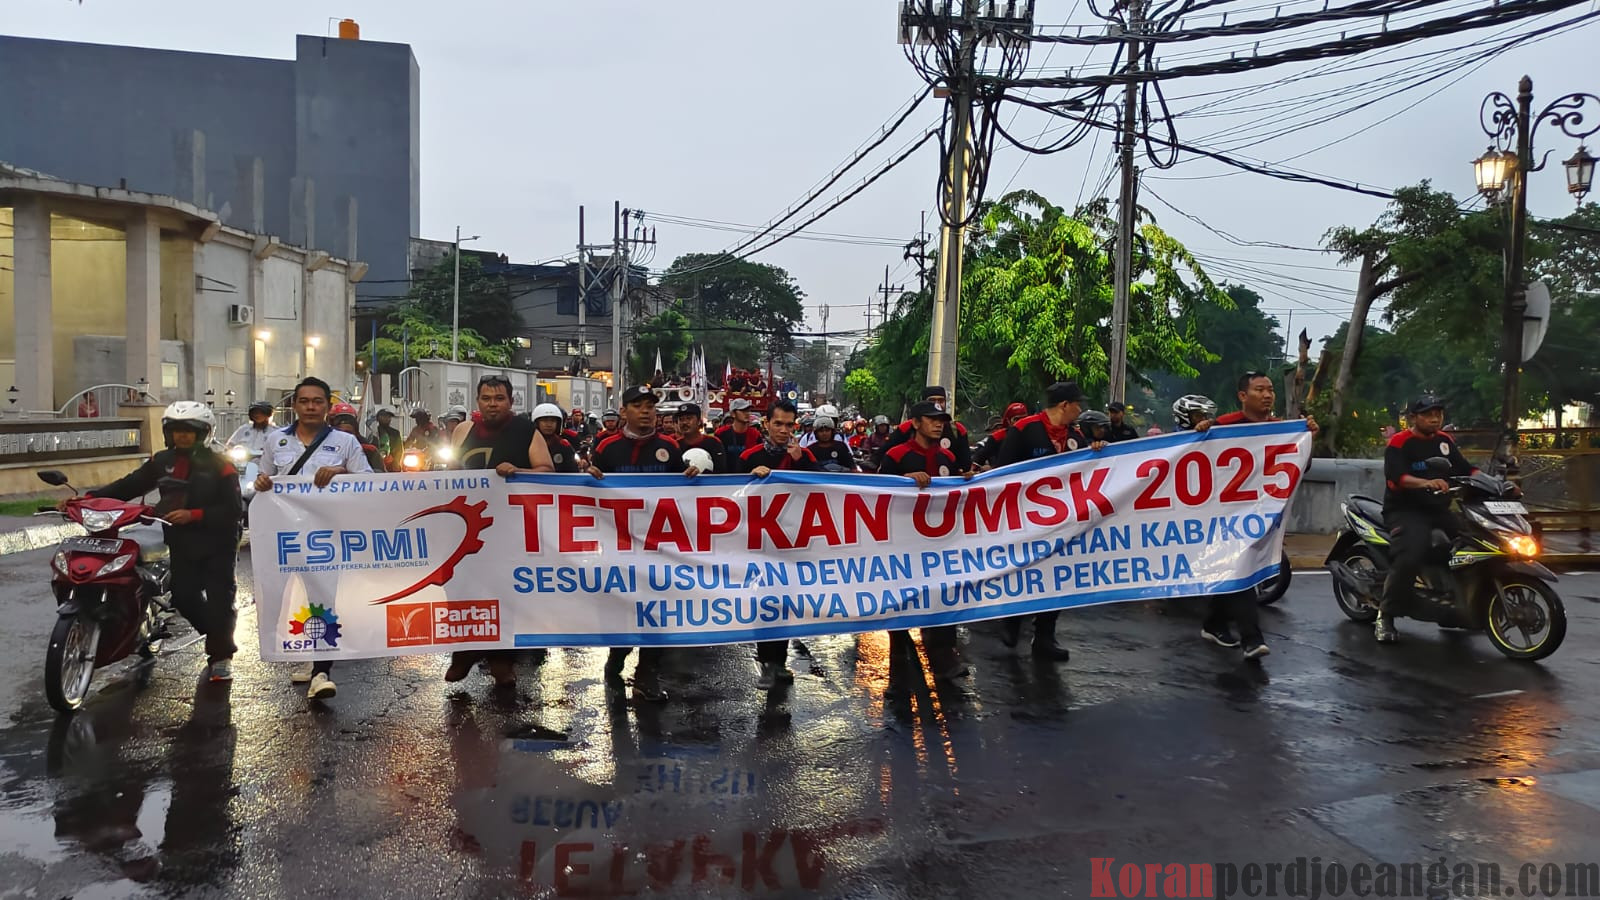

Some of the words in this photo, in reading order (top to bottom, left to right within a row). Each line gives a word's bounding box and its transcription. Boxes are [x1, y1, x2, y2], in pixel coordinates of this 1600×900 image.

[274, 482, 312, 494] DPW
[379, 480, 427, 492] JAWA
[433, 477, 490, 490] TIMUR
[508, 492, 892, 552] TETAPKAN
[912, 467, 1114, 538] UMSK
[1134, 443, 1301, 510] 2025
[277, 528, 428, 565] FSPMI
[311, 564, 339, 572] SERIKAT
[341, 562, 371, 571] PEKERJA
[394, 560, 430, 568] INDONESIA
[513, 565, 636, 593] SESUAI
[649, 561, 789, 592] USULAN
[796, 554, 912, 585] DEWAN
[921, 525, 1131, 577] PENGUPAHAN
[636, 593, 848, 627] KHUSUSNYA
[856, 584, 930, 617] DARI
[941, 568, 1045, 606] UNSUR
[1054, 553, 1193, 591] PEKERJA
[435, 605, 496, 622] Partai
[435, 622, 498, 638] Buruh
[283, 639, 317, 649] KSPI
